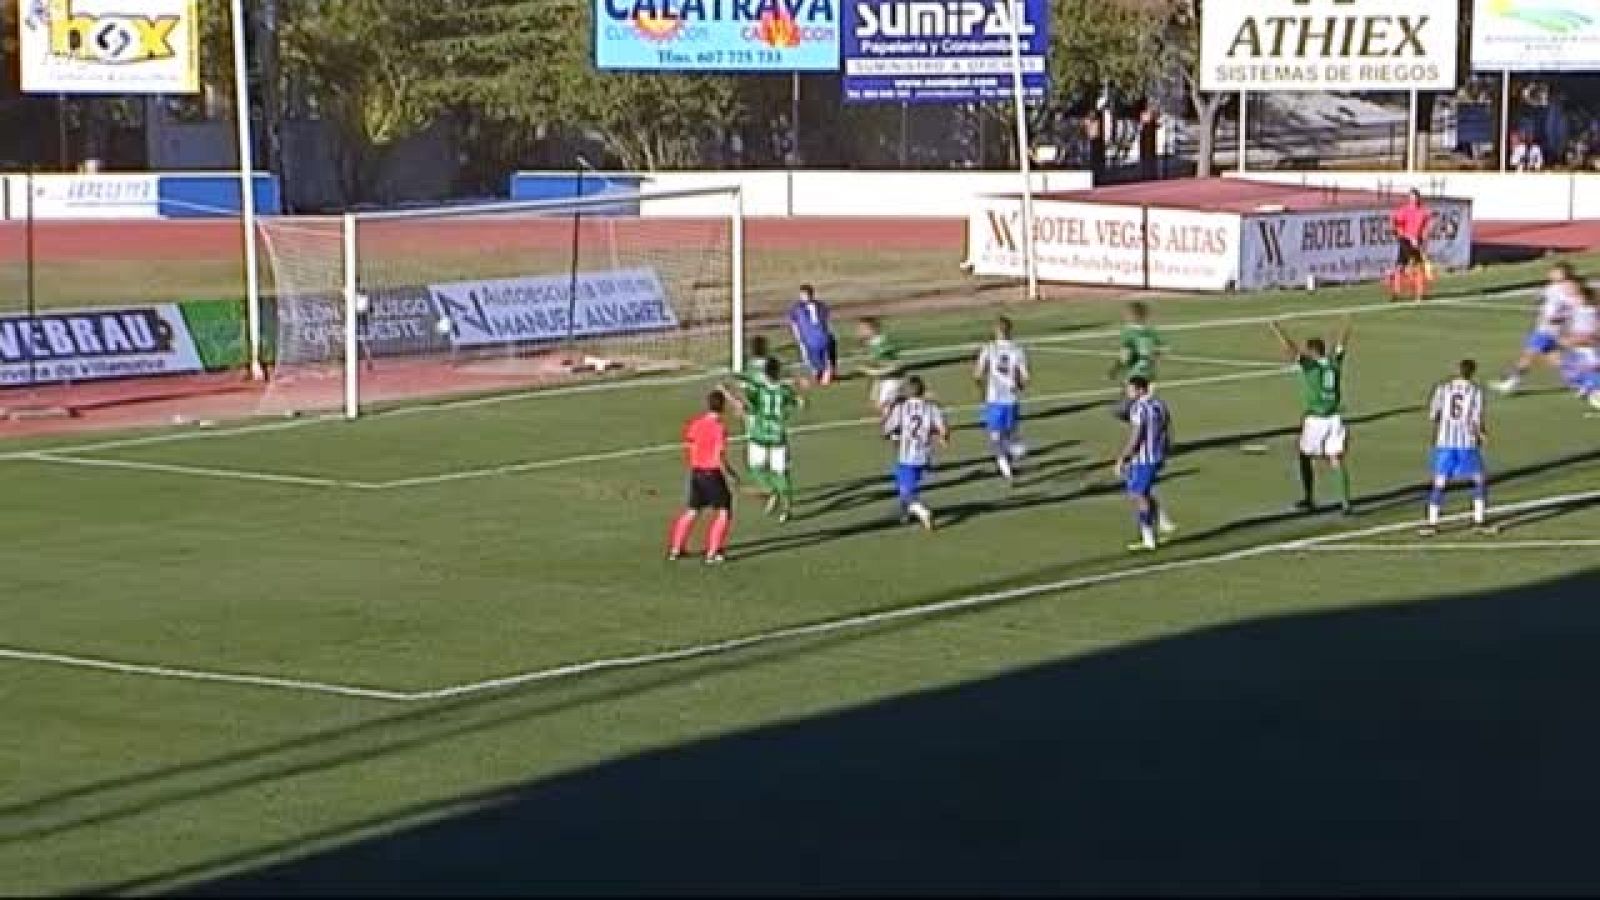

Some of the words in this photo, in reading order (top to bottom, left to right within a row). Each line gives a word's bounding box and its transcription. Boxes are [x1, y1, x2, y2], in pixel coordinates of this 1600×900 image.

[1226, 15, 1430, 58] ATHIEX
[1215, 64, 1318, 81] SISTEMAS
[1324, 64, 1351, 81] DE
[1359, 64, 1440, 81] RIEGOS
[1166, 225, 1226, 255] ALTAS
[1302, 217, 1353, 251] HOTEL
[1452, 394, 1464, 421] 6
